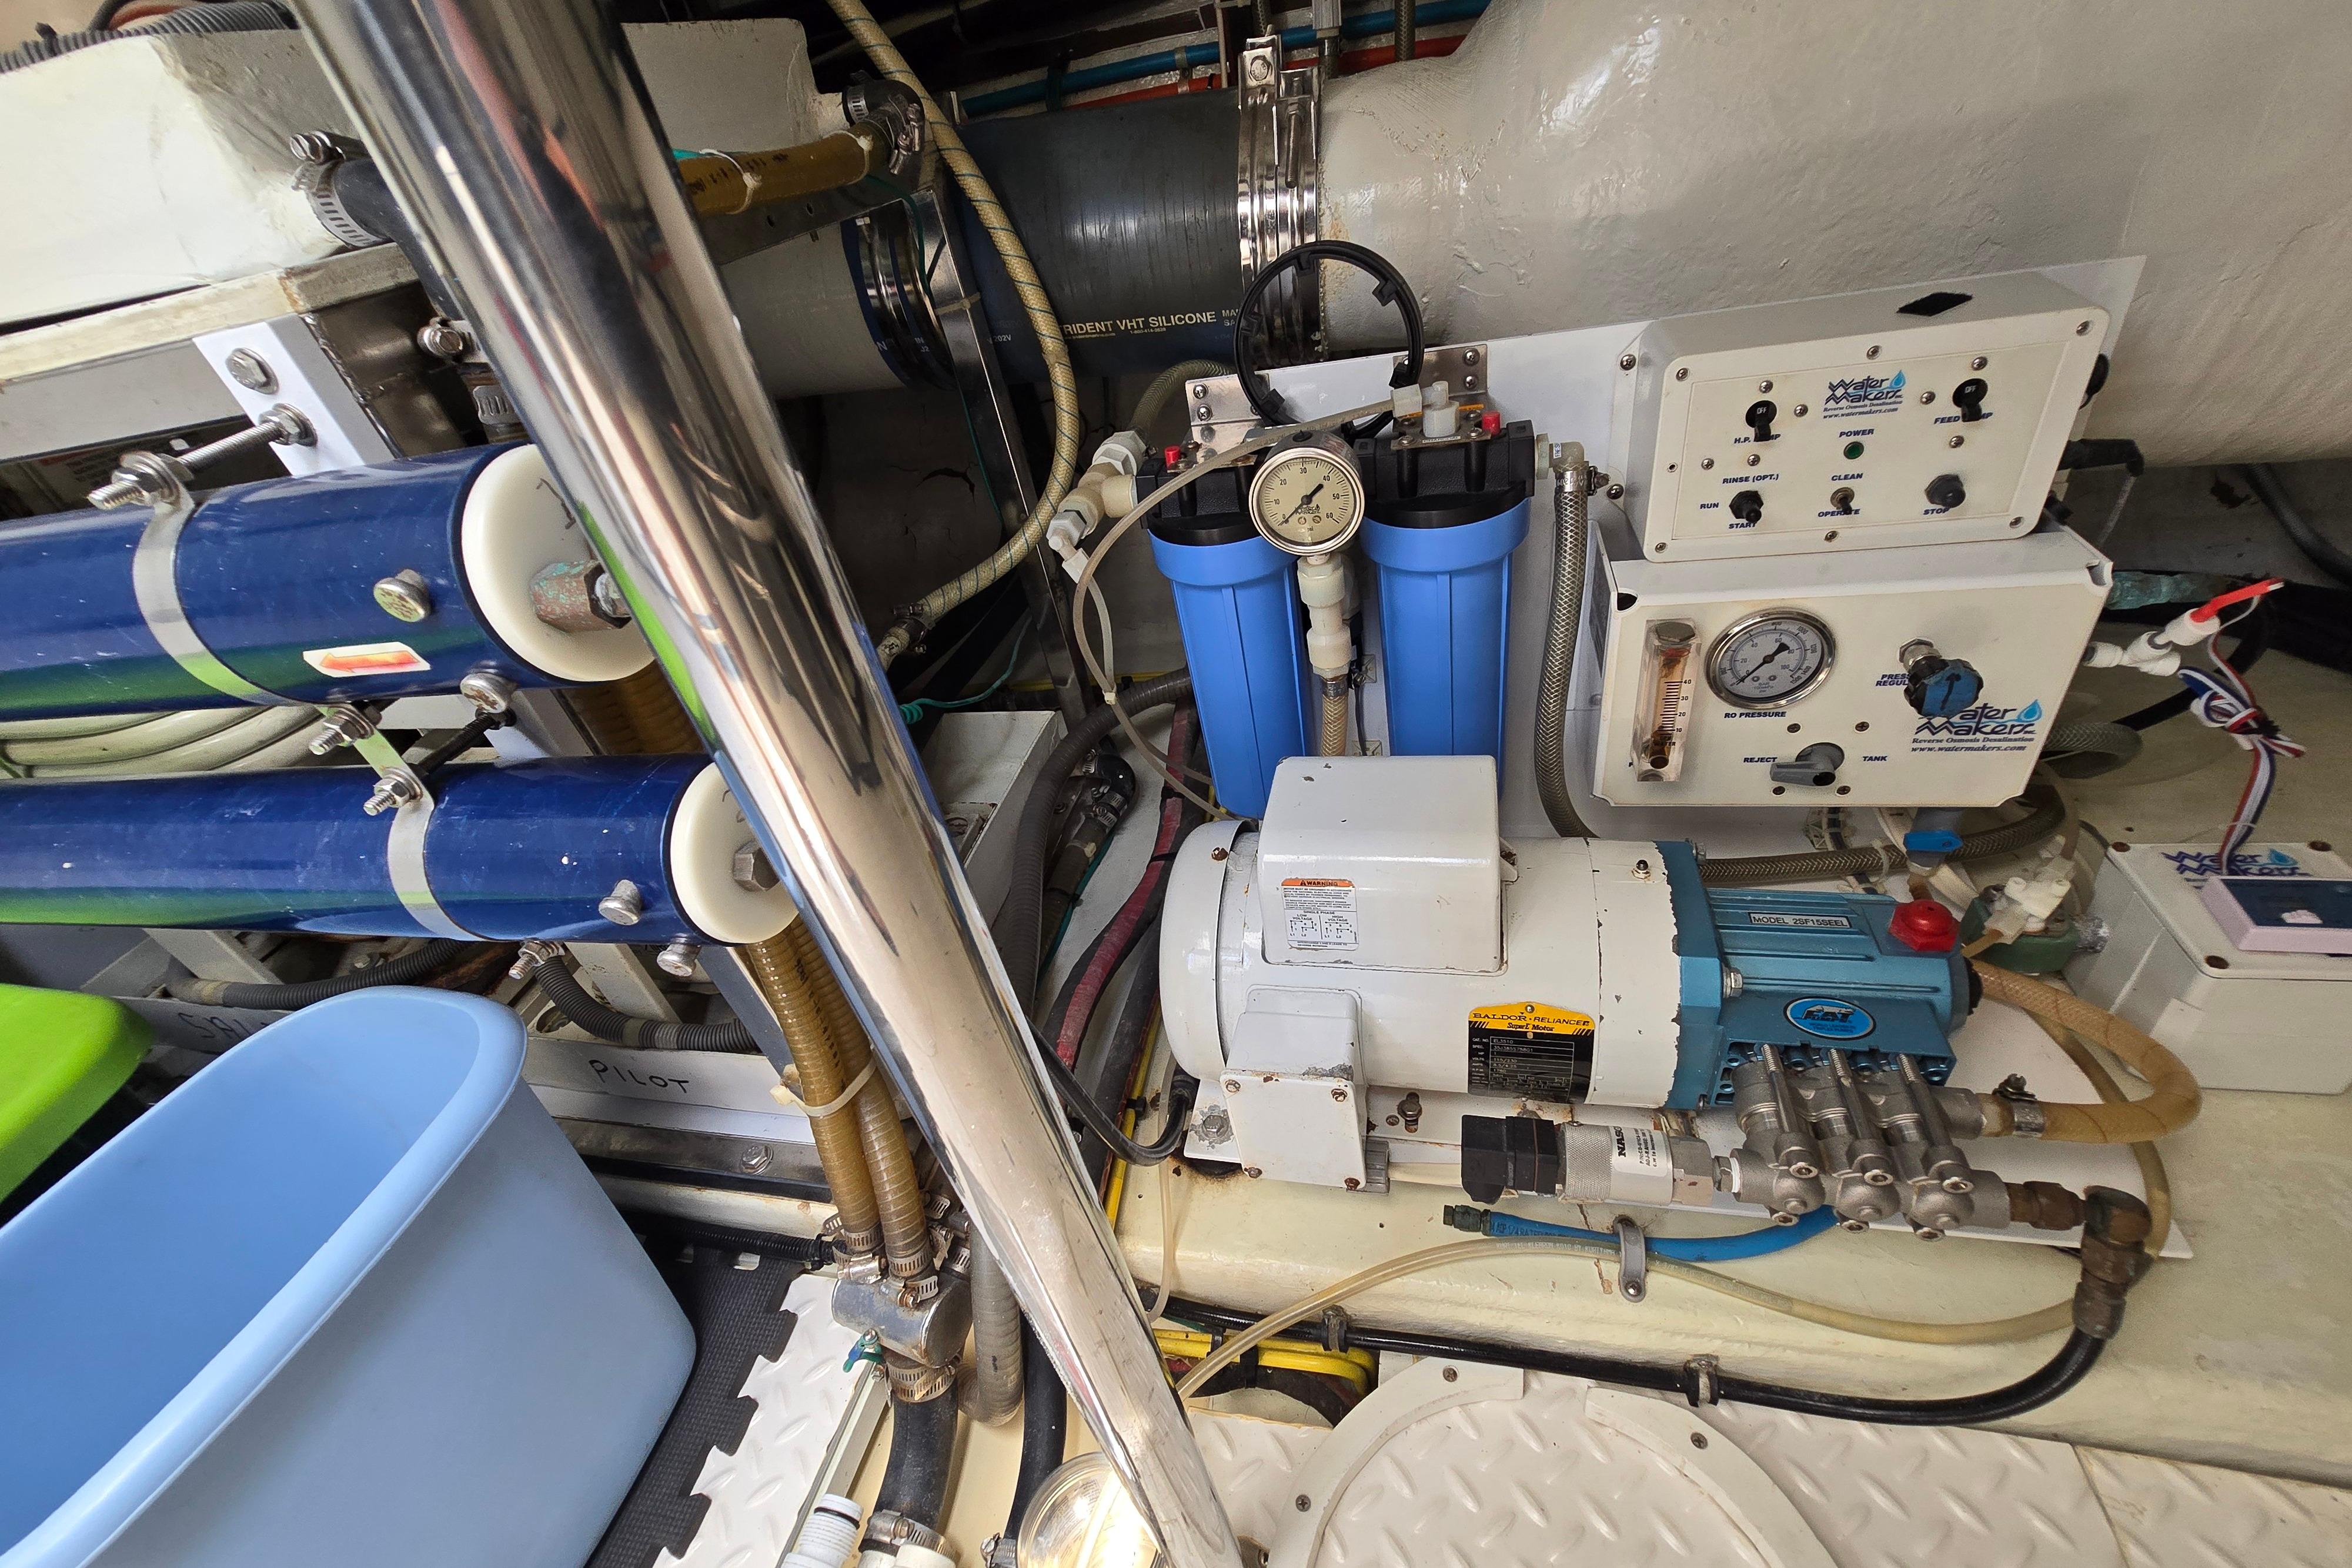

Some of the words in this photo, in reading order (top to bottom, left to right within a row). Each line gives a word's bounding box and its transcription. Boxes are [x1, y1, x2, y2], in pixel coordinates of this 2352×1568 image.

[1060, 320, 1112, 336] RIDENT
[1116, 317, 1145, 330] VHT
[1148, 311, 1217, 328] SILICONE
[1828, 376, 1889, 391] Water
[1965, 385, 1976, 393] OFF
[1825, 389, 1902, 405] Makers
[1934, 415, 1960, 424] FEED
[1839, 429, 1875, 437] POWER
[1722, 476, 1750, 484] RINSE
[1752, 474, 1779, 483] (OPT.)
[1830, 473, 1863, 481] CLEAN
[1915, 719, 2034, 735] Makers
[1752, 916, 1789, 924] MODEL
[1792, 918, 1847, 927] 2SF15SEEL
[1473, 1012, 1527, 1021] BALDOR
[589, 1059, 689, 1094] PILOT
